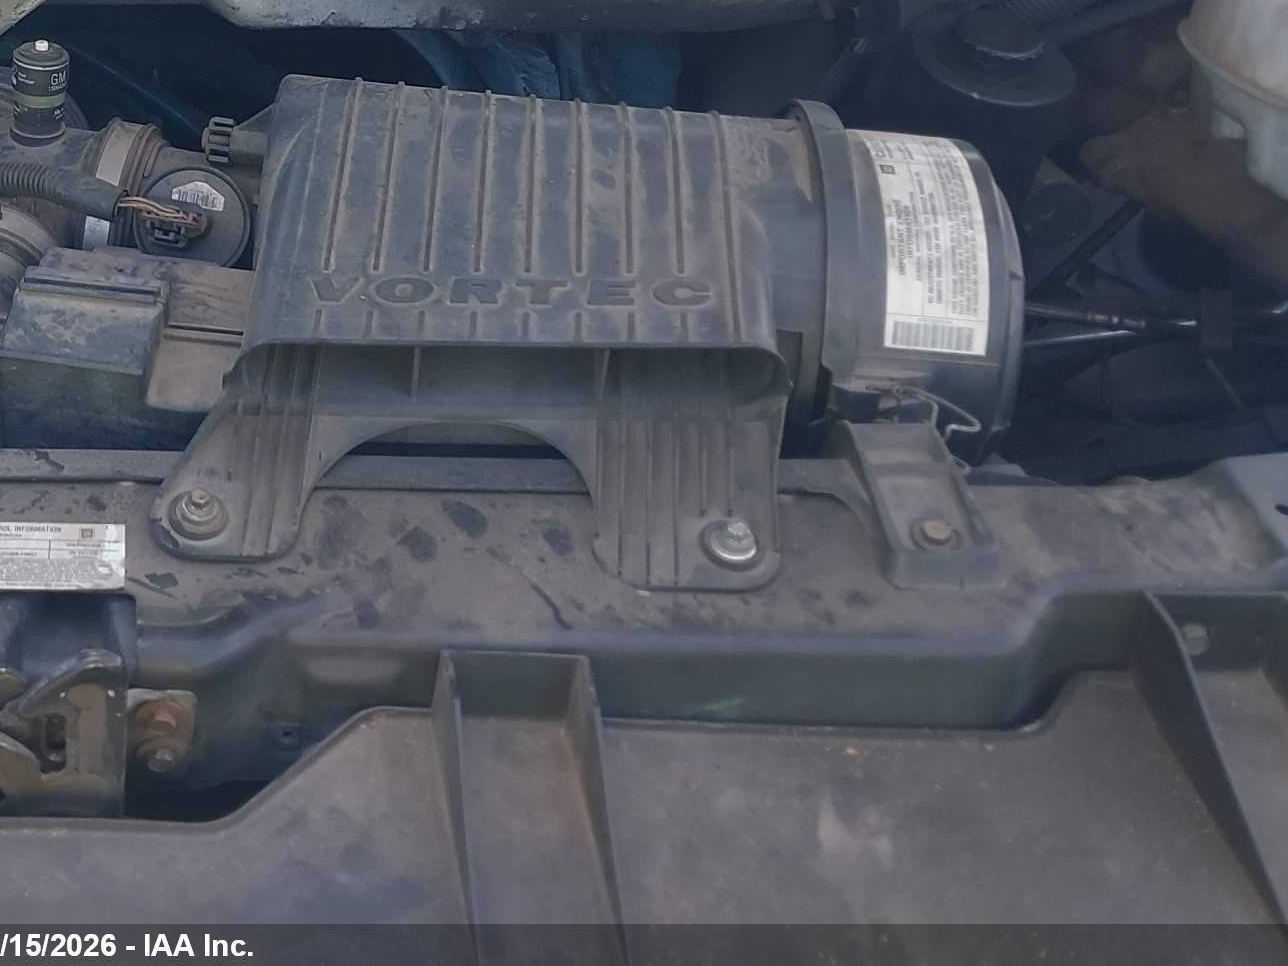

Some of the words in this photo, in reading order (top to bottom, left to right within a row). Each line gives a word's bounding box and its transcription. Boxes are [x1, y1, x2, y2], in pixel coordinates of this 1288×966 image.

[51, 70, 66, 86] GM
[309, 276, 714, 308] VORTEC
[14, 525, 62, 533] INFORMATION
